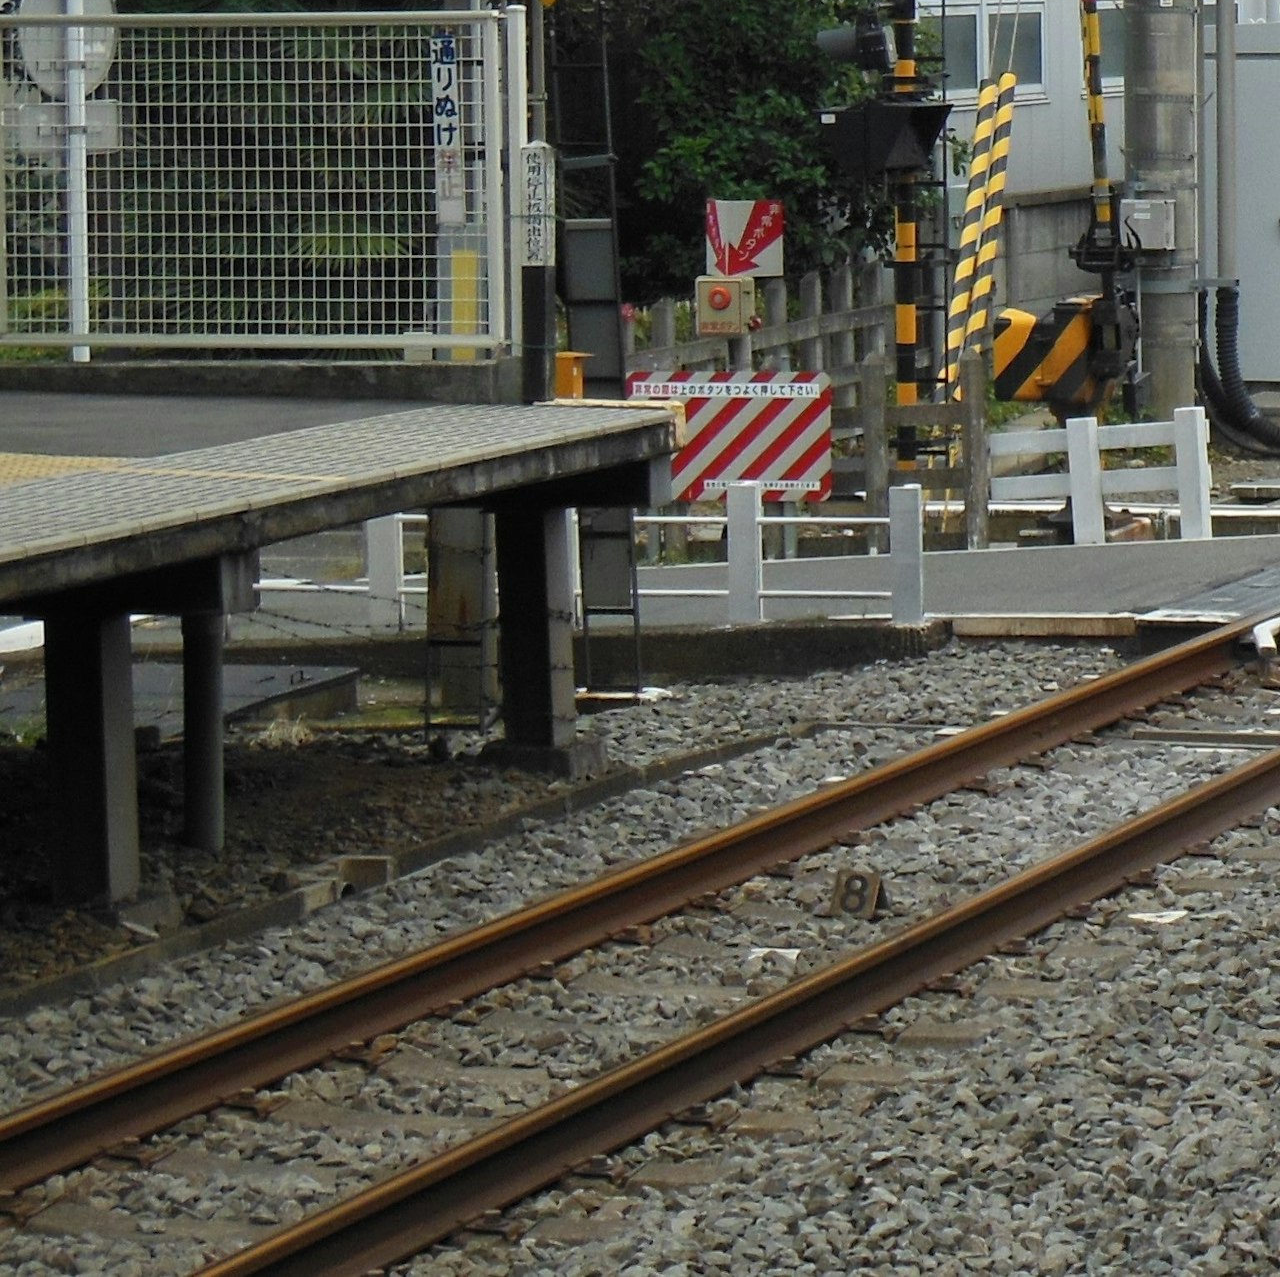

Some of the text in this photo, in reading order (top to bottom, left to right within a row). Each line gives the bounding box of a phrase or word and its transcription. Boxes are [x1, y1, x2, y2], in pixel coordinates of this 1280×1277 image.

[431, 37, 459, 201] 通りぬけ禁止
[739, 204, 782, 261] 非常ボタン
